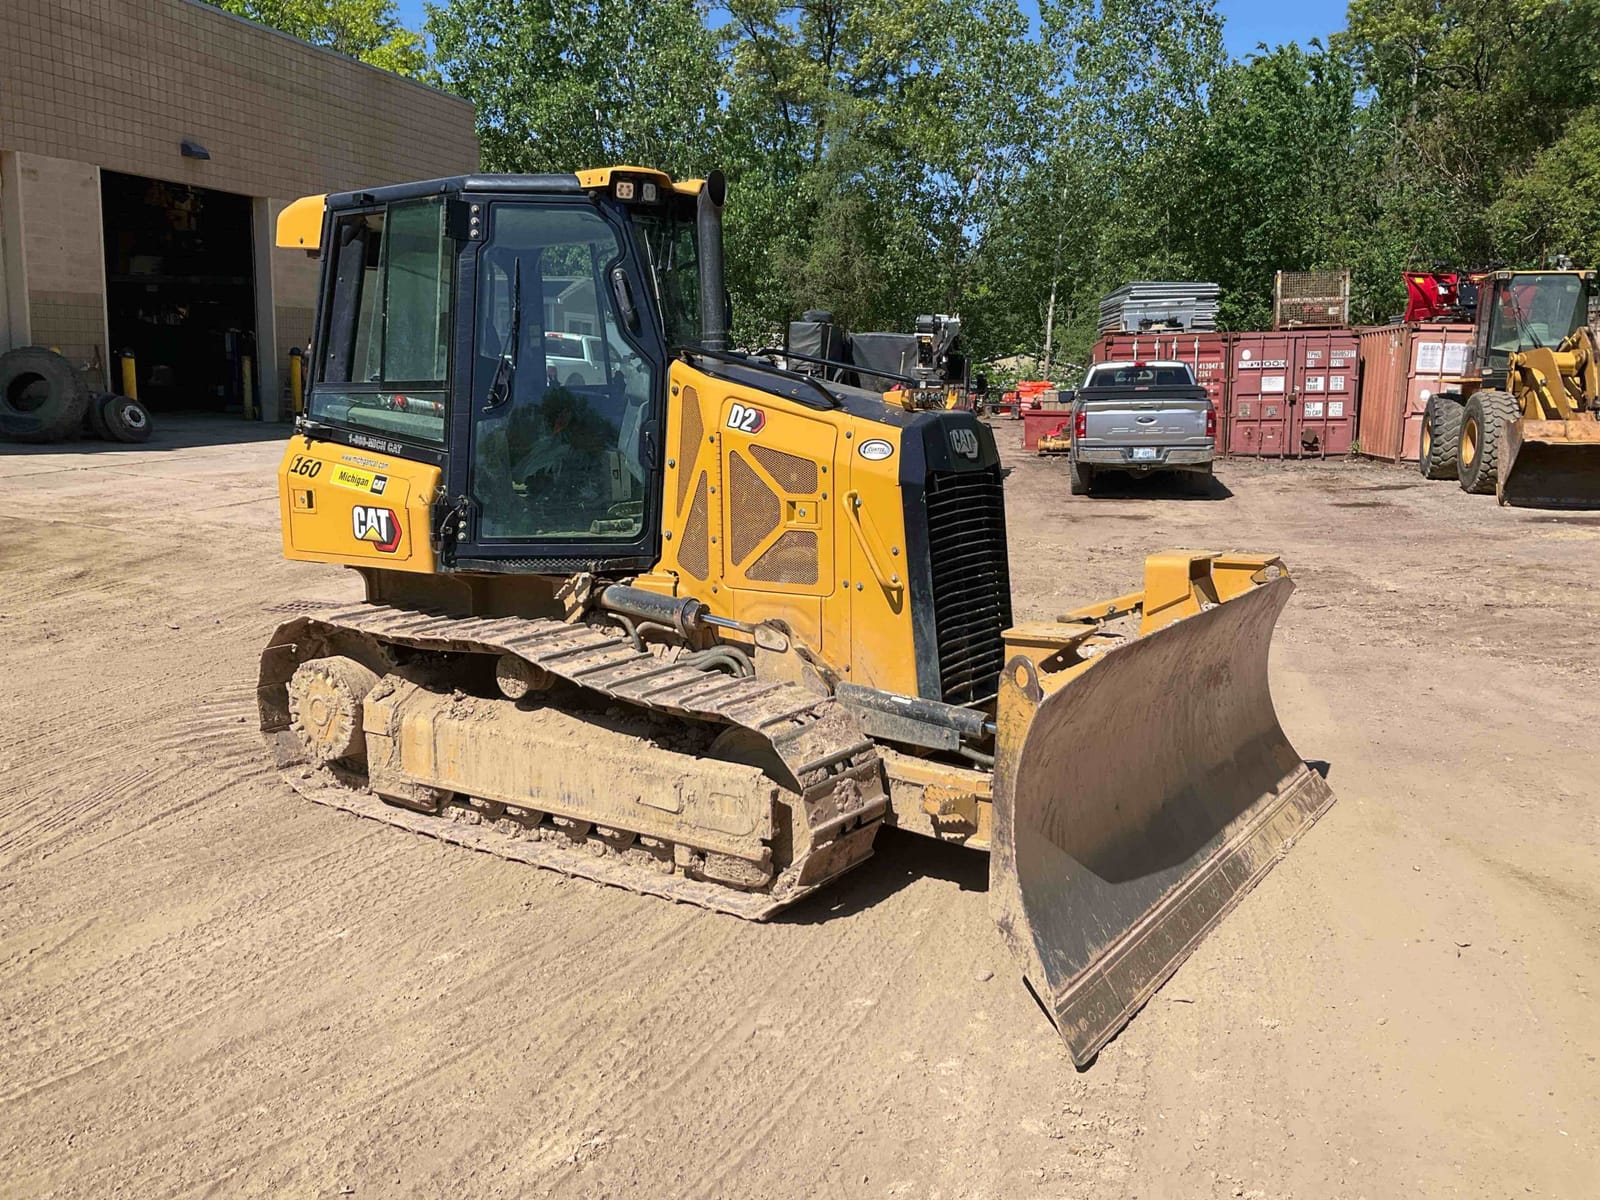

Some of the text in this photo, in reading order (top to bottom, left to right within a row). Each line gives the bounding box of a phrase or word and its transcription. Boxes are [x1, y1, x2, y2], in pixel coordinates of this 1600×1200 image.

[728, 404, 753, 431] D2
[951, 429, 977, 452] CAT
[291, 457, 322, 478] 160
[338, 471, 386, 491] Michigan CAT
[353, 506, 389, 541] CAT
